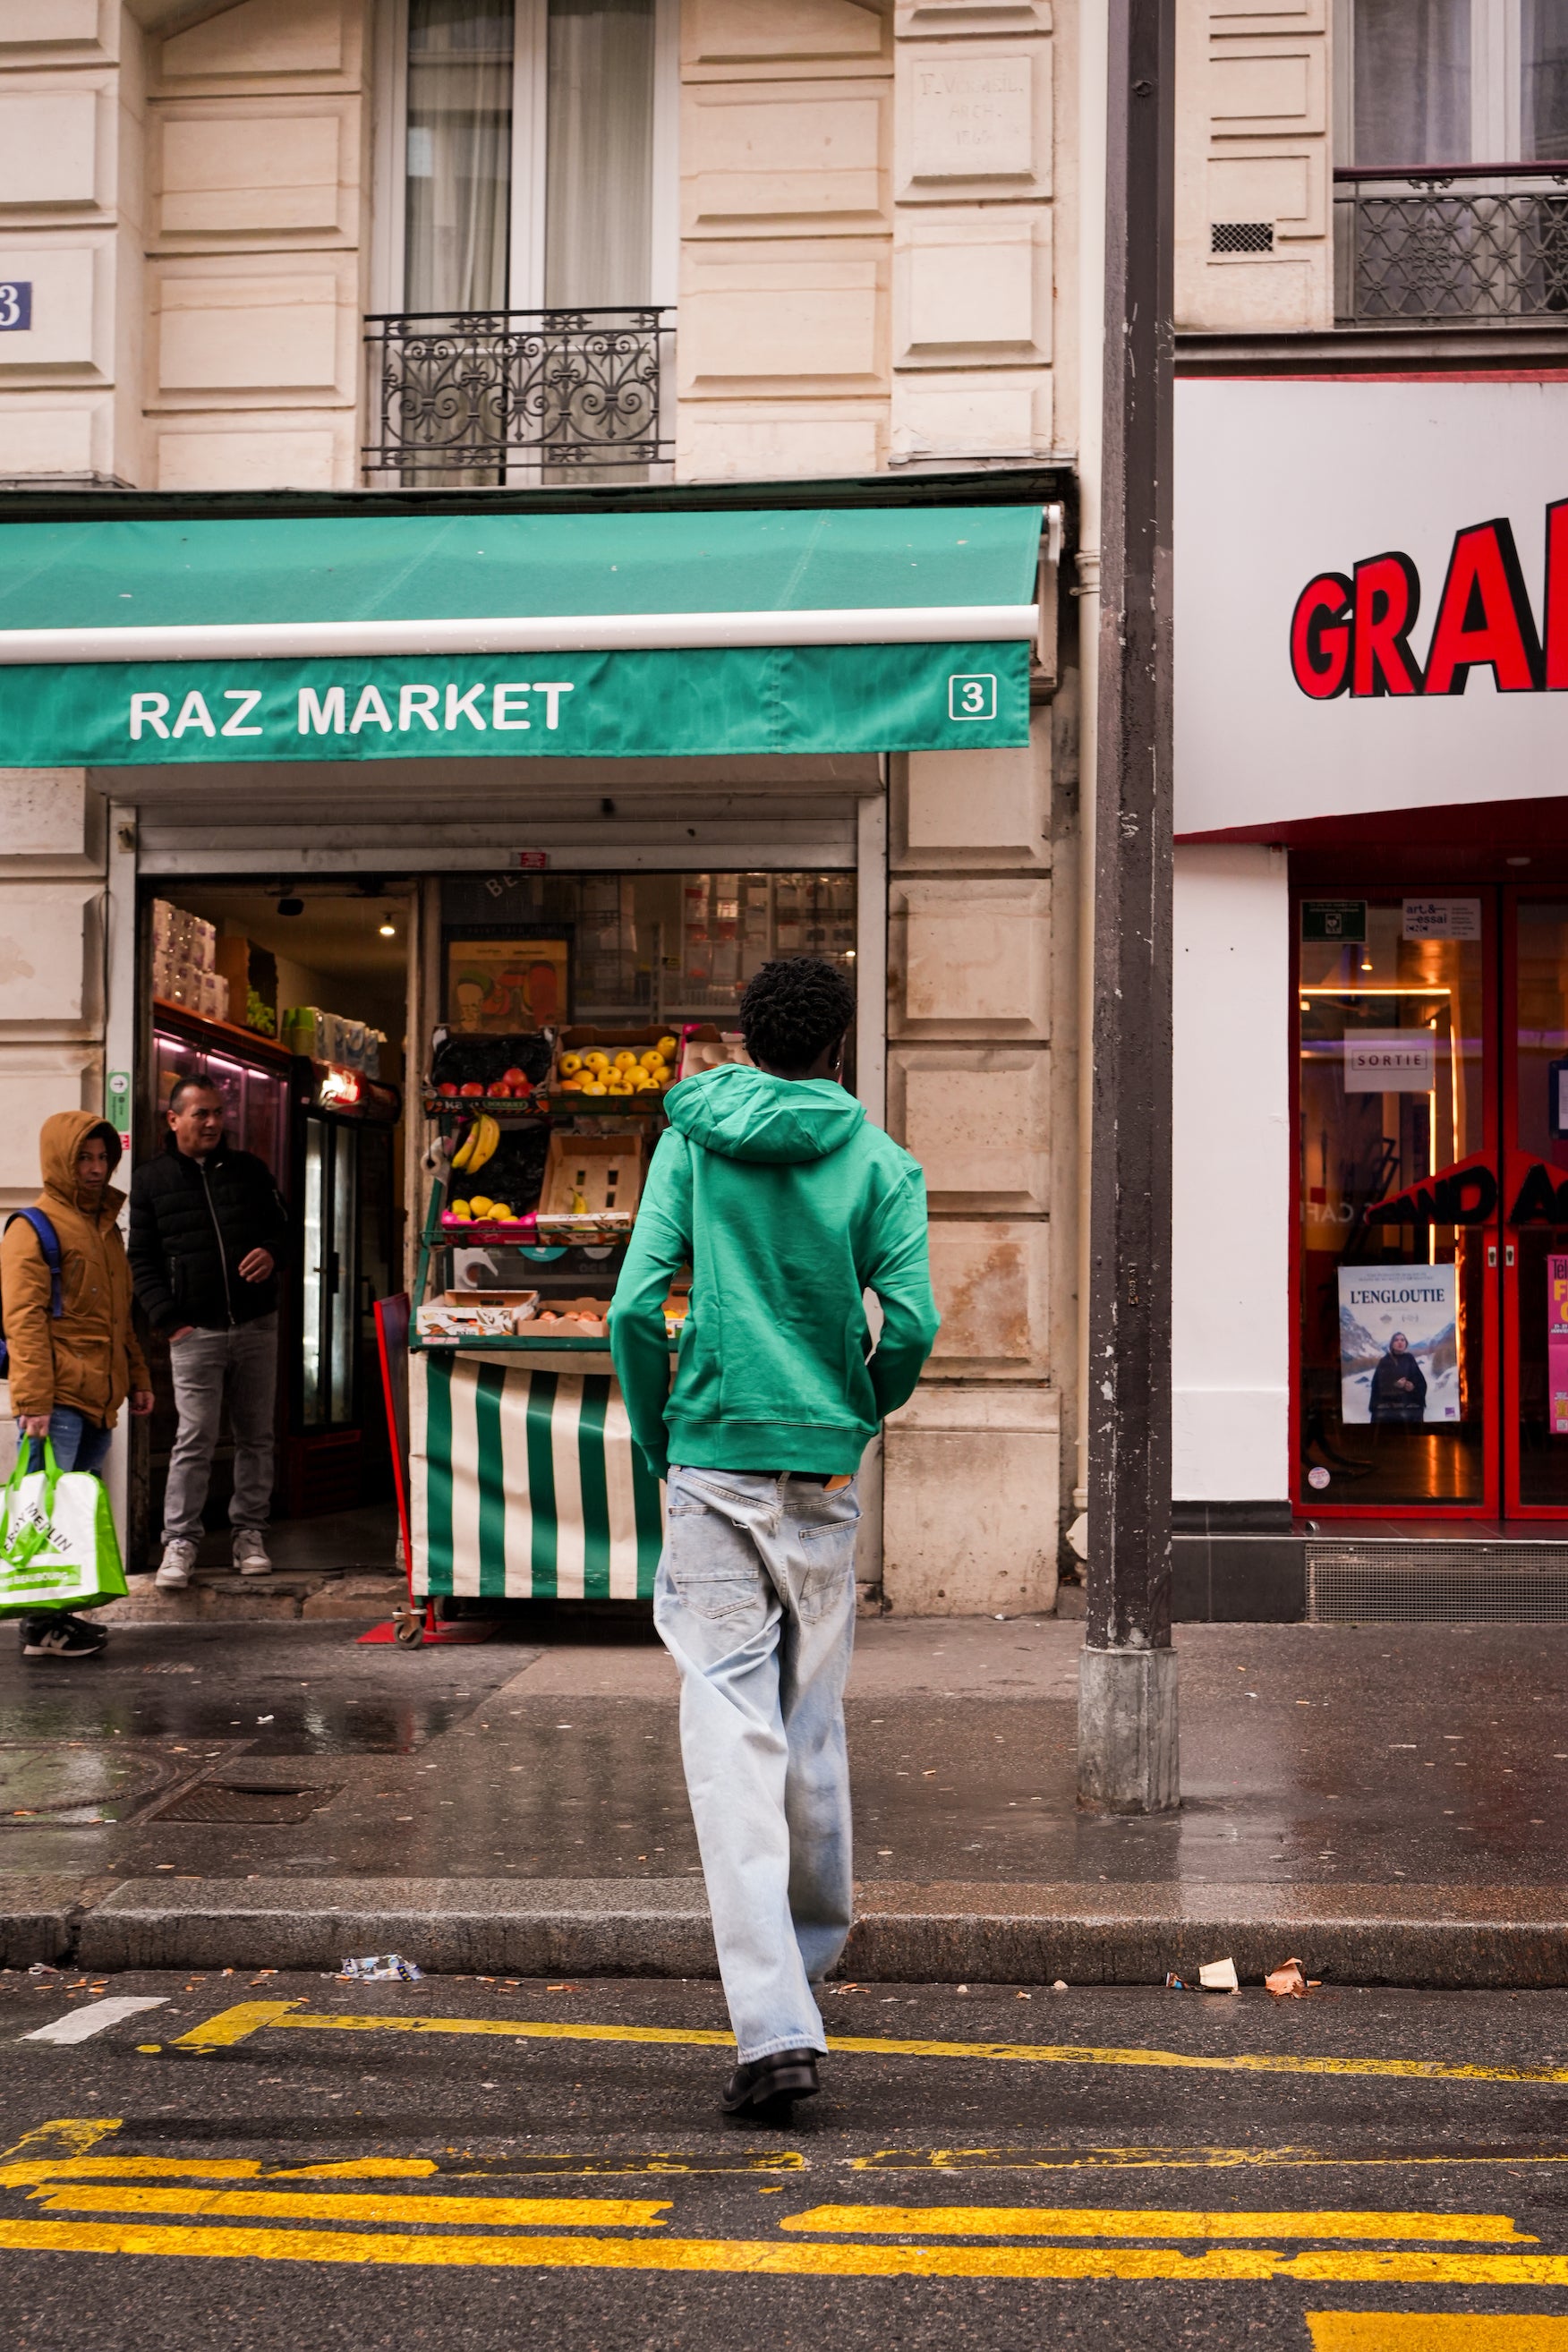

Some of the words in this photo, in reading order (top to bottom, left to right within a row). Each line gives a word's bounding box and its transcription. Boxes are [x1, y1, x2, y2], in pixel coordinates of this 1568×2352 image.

[961, 682, 984, 713] 3
[130, 689, 263, 741] RAZ
[297, 682, 575, 736] MARKET
[1357, 1054, 1421, 1067] SORTIE
[1350, 1288, 1445, 1305] L'ENGLOUTIE
